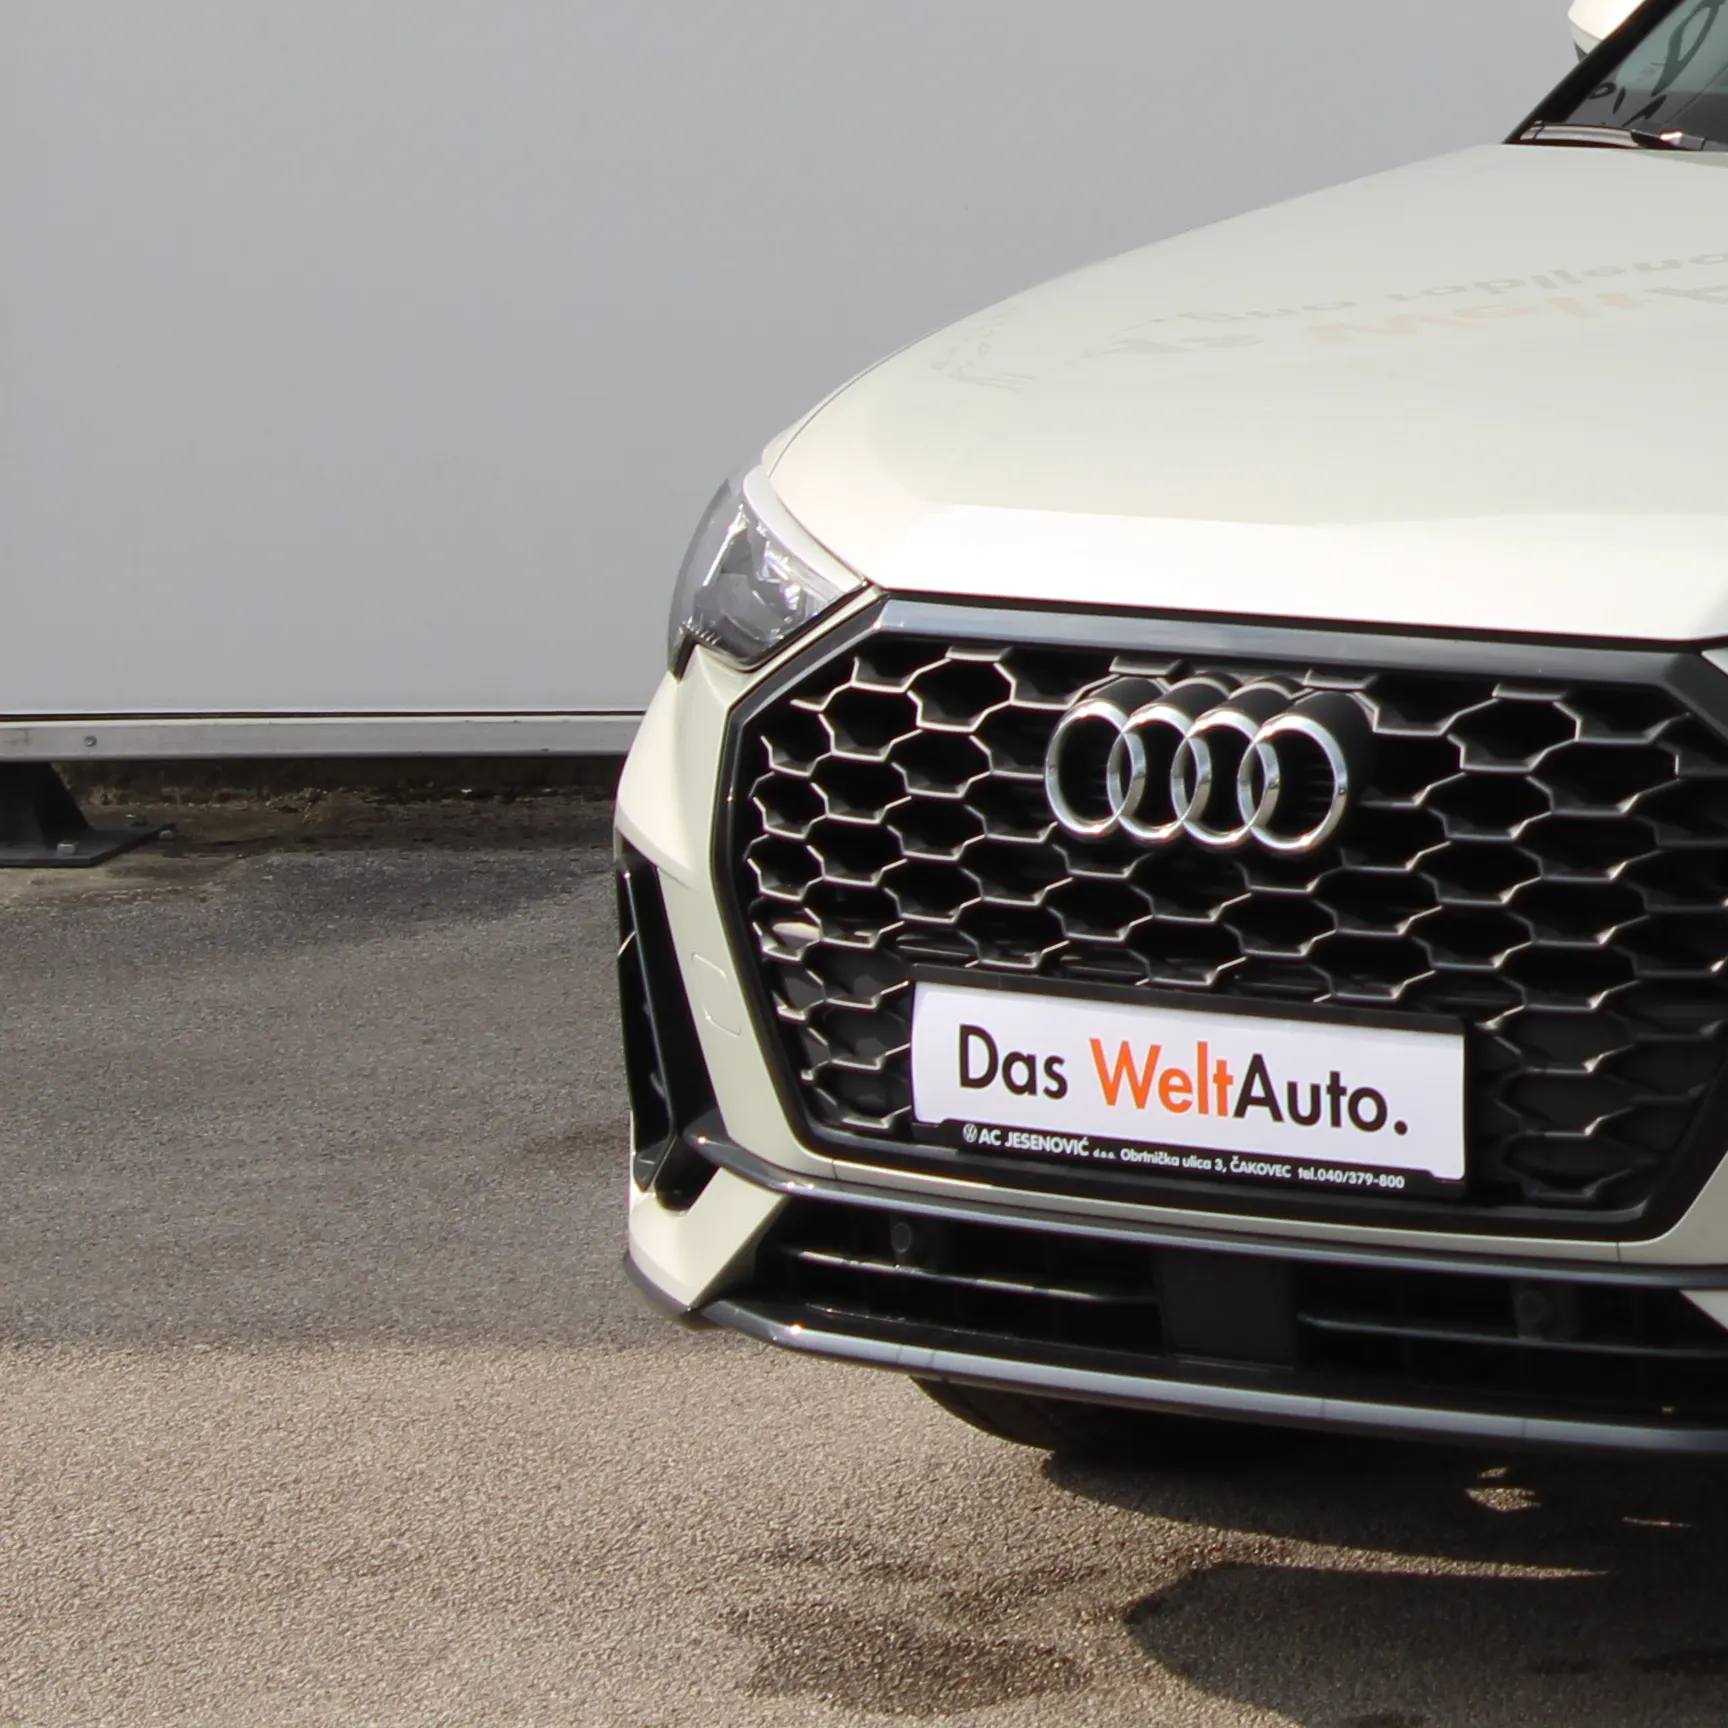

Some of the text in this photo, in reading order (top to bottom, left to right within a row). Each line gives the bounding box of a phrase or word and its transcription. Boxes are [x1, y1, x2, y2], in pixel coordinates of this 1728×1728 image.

[958, 1023, 1409, 1136] Das WeltAuto.
[979, 1128, 1001, 1146] AC
[1005, 1131, 1089, 1157] JESENOVIĆ
[1120, 1148, 1180, 1168] Obrtnička
[1182, 1155, 1212, 1171] ulica
[1214, 1158, 1227, 1174] 3,
[1230, 1155, 1292, 1179] ČAKOVEC
